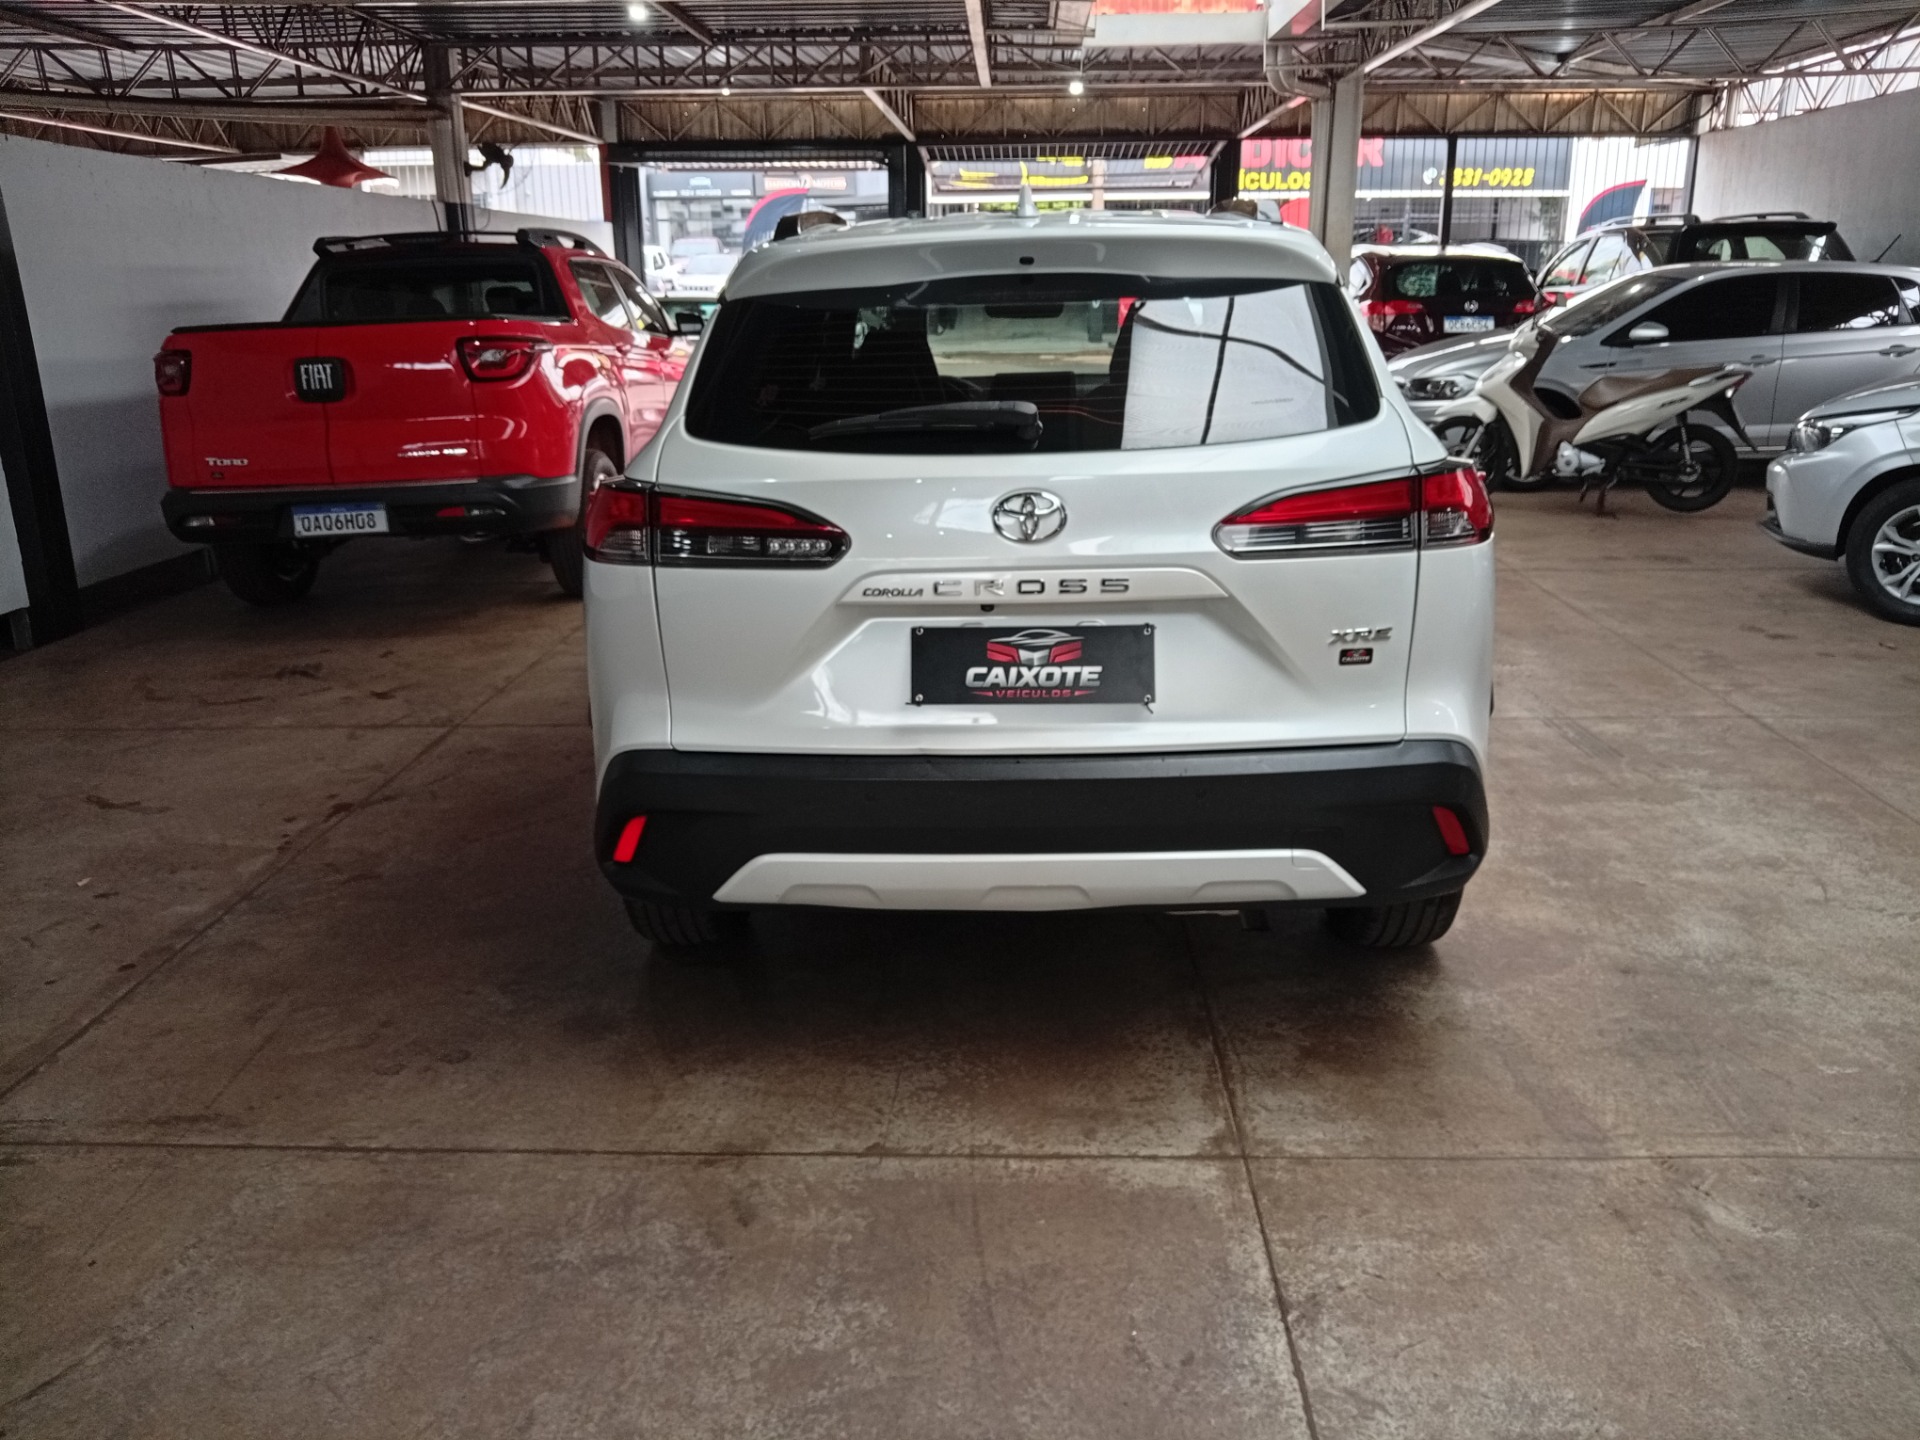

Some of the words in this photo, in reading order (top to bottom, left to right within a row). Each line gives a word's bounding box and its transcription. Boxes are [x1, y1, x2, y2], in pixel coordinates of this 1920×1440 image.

[299, 363, 333, 391] FIAT
[862, 587, 924, 598] COROLLA
[932, 578, 1130, 597] CROSS
[1327, 626, 1393, 647] XRE
[965, 665, 1103, 688] CAIXOTE
[996, 688, 1072, 699] VEÍCULOS
